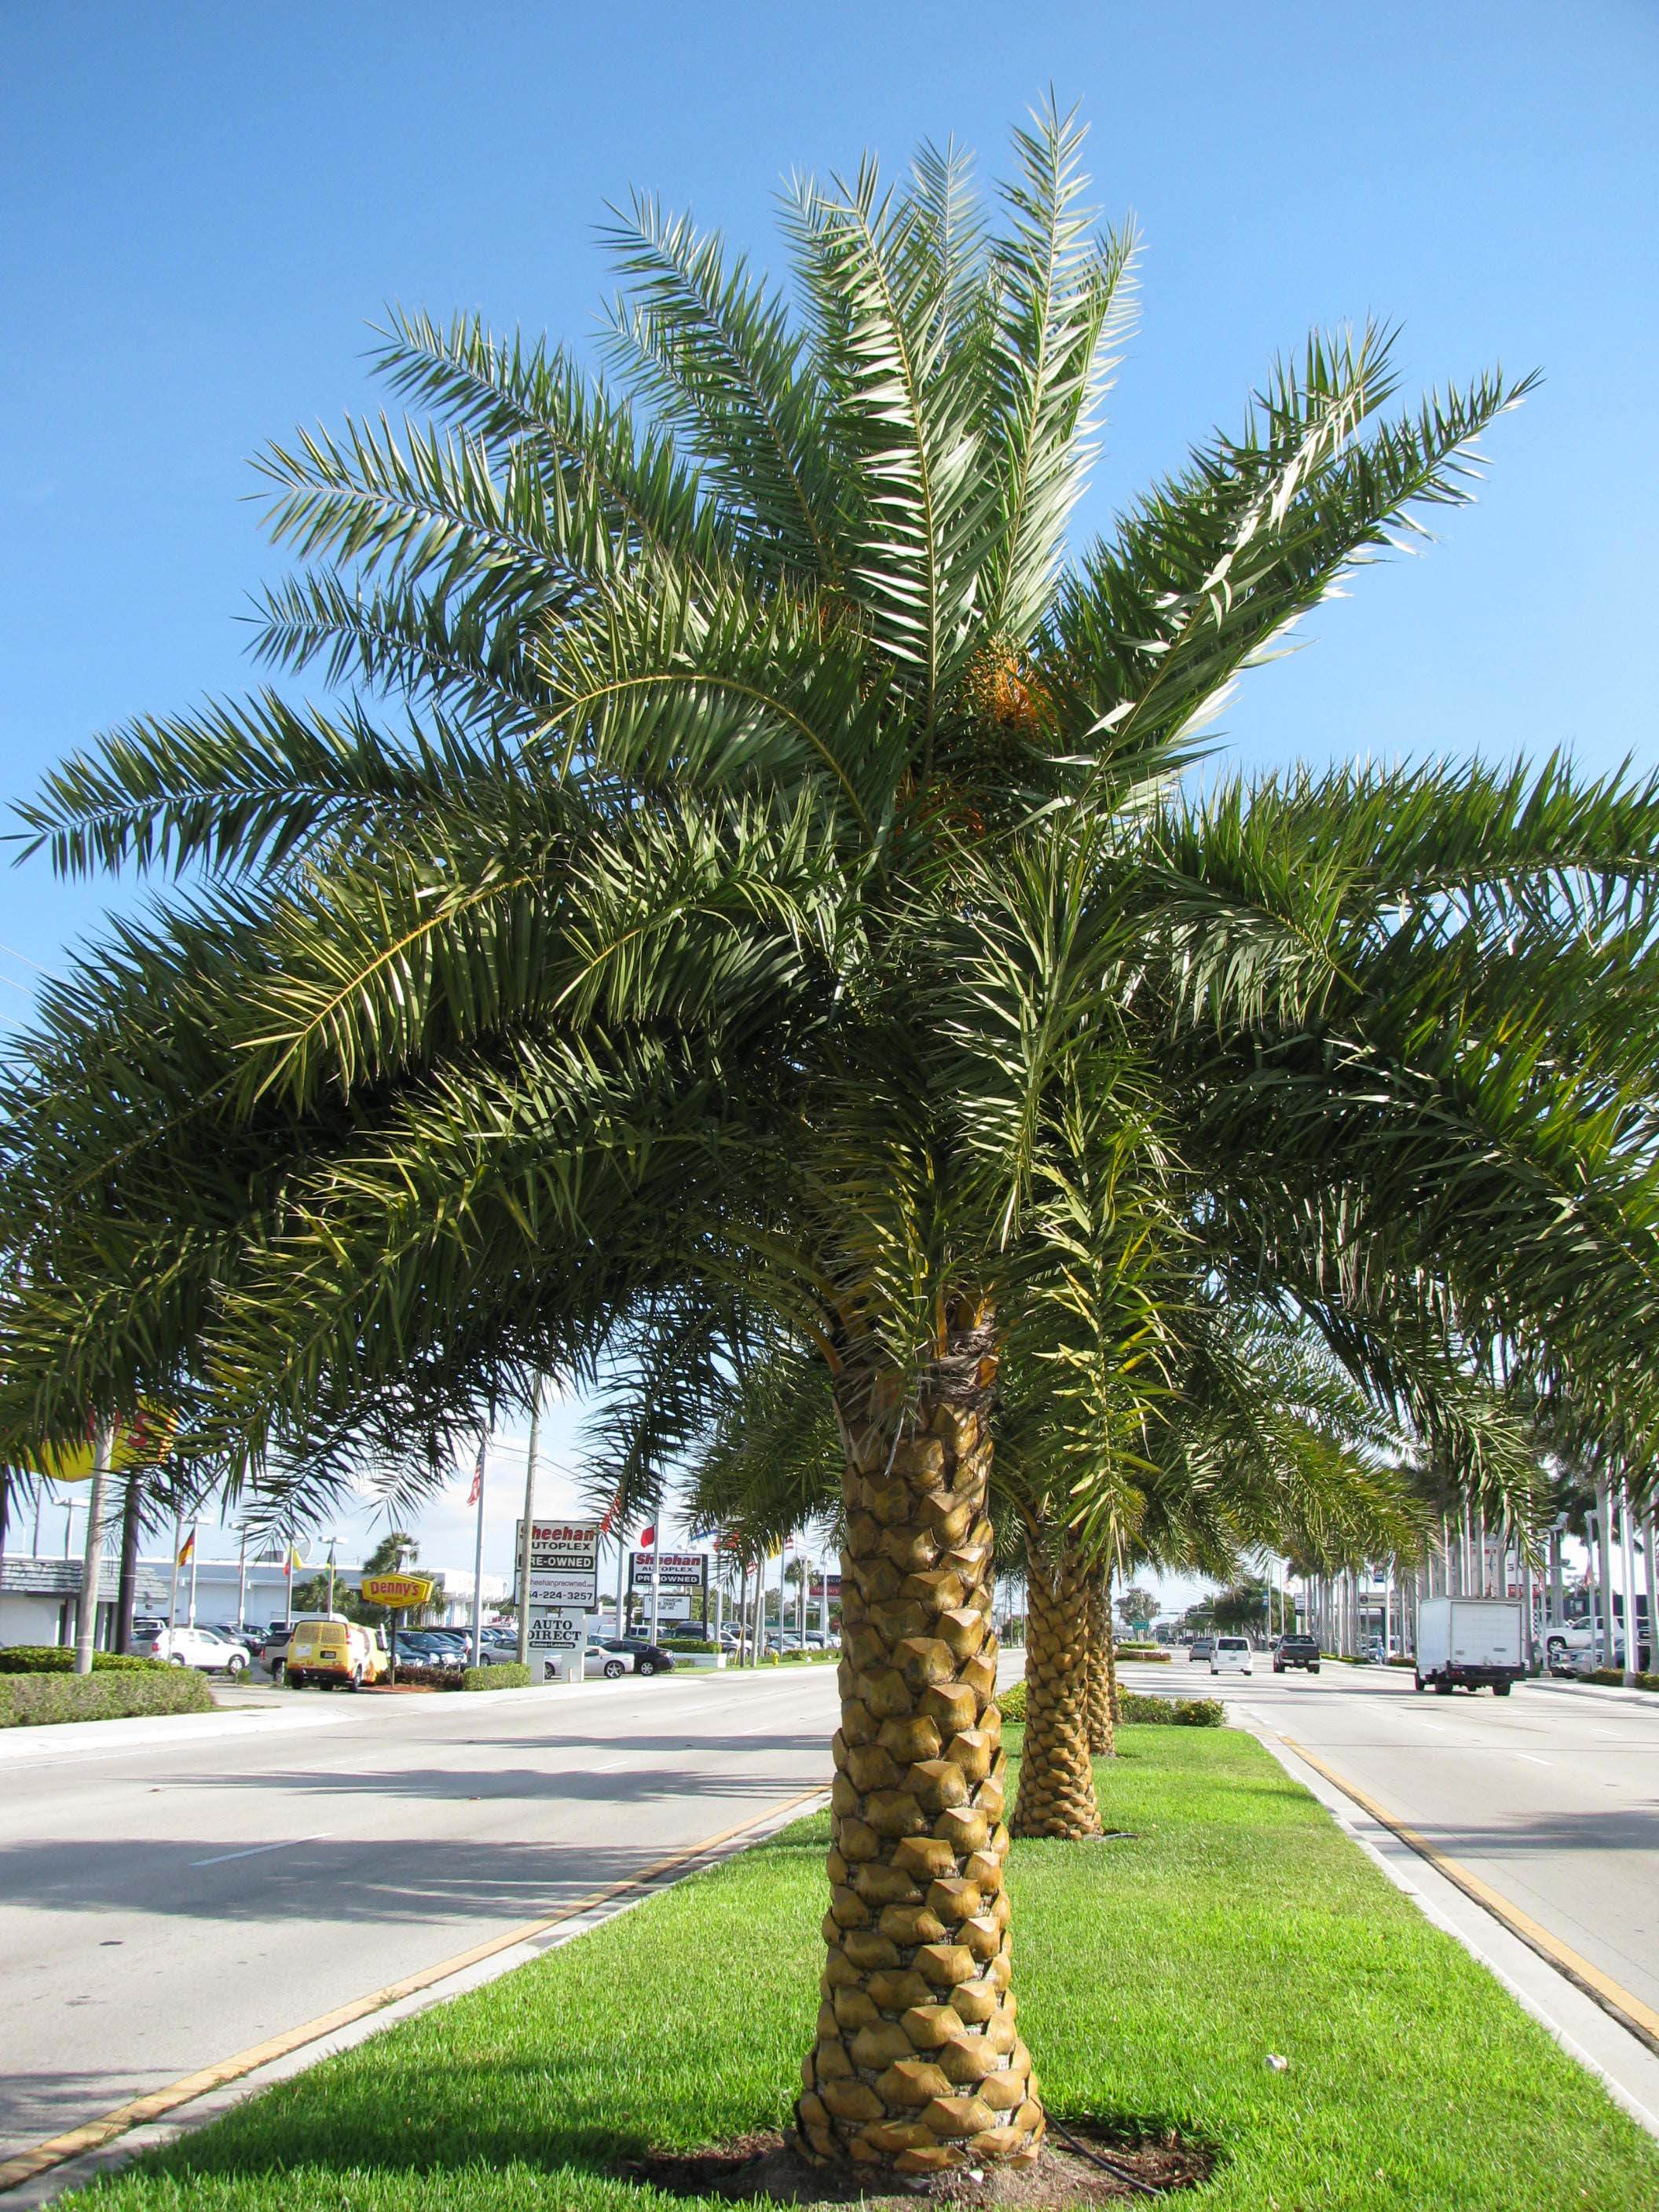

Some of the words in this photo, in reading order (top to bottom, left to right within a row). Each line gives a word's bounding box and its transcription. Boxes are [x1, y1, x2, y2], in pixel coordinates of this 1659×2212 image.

[520, 1525, 595, 1541] heehan
[532, 1541, 591, 1551] UTOPLEX
[530, 1556, 591, 1567] RE-OWNED
[371, 1581, 419, 1595] Denny's
[529, 1591, 593, 1599] 4-224-3257
[533, 1619, 573, 1631] AUTO
[528, 1630, 582, 1640] DIRECT
